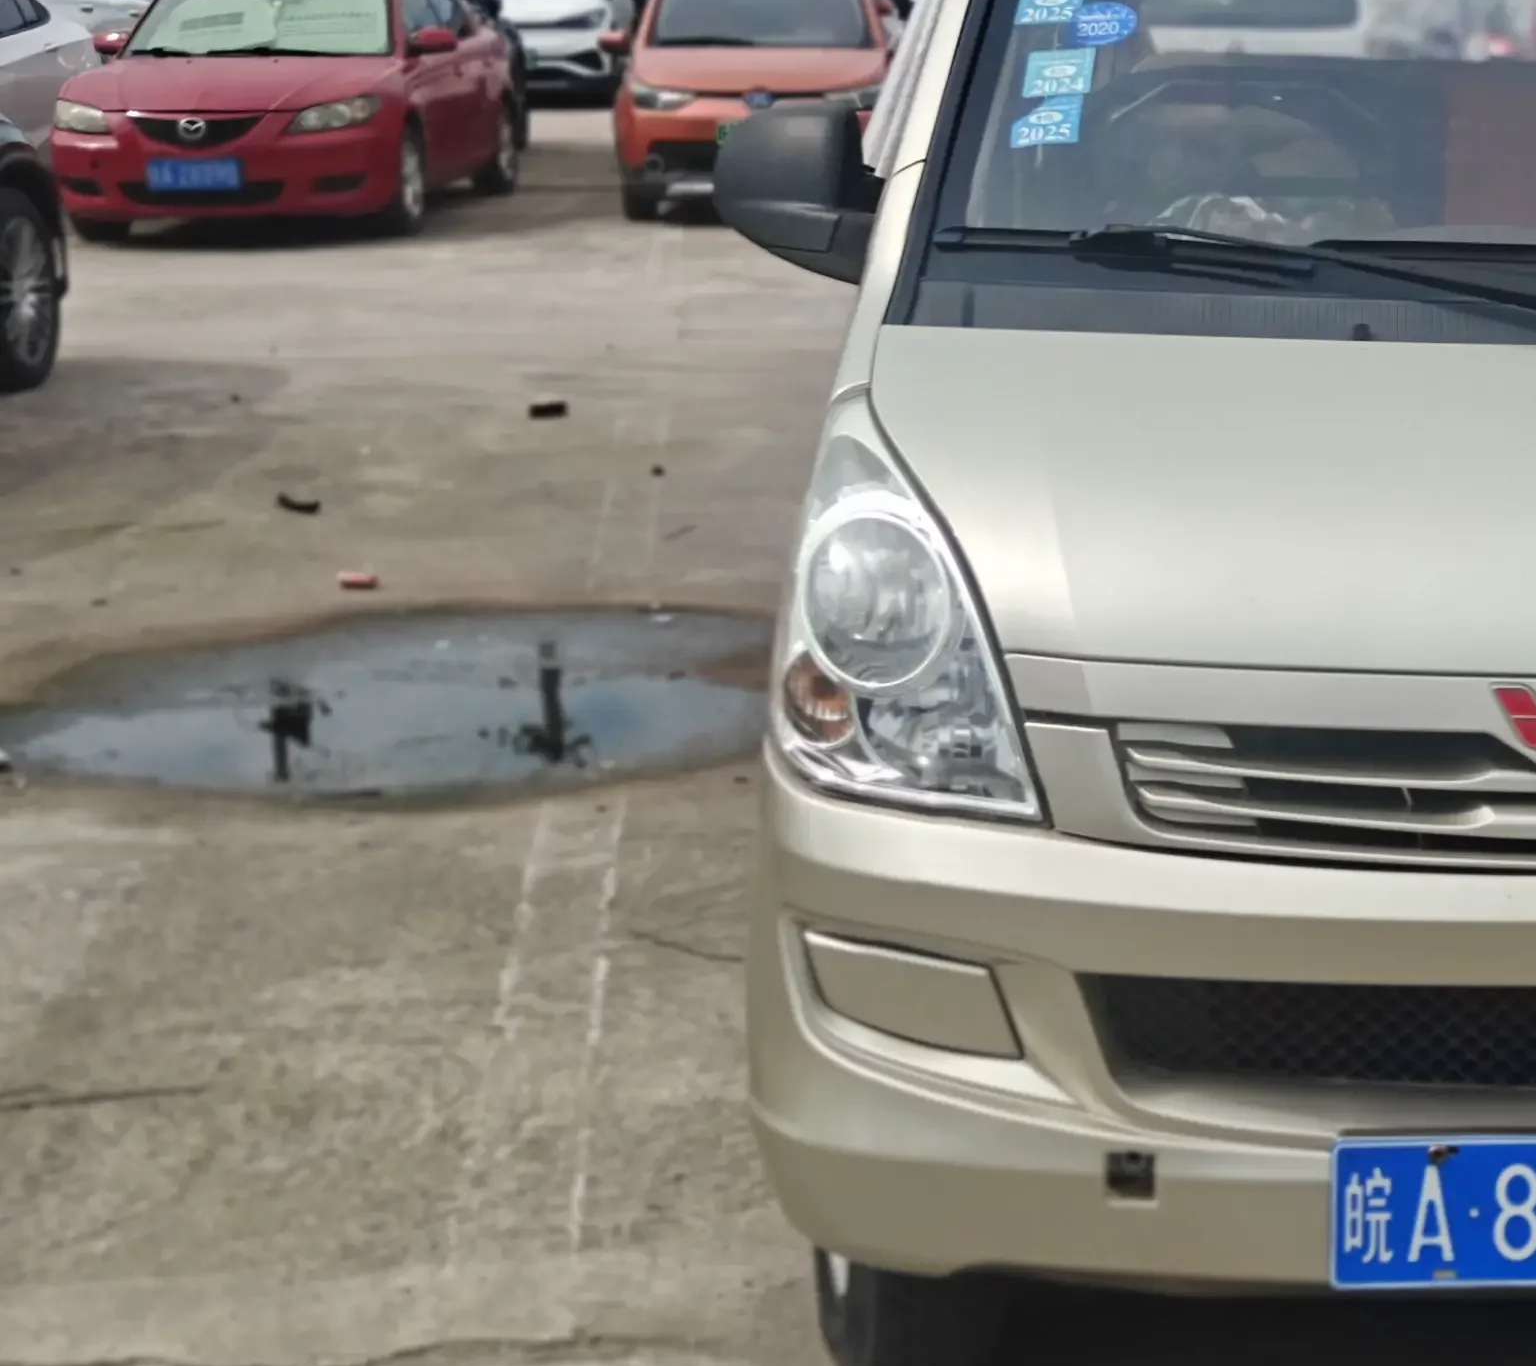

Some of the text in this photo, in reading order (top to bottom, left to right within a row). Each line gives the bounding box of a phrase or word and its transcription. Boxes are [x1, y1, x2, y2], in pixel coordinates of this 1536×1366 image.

[1020, 6, 1073, 23] 2025
[1077, 21, 1119, 37] 2020
[1031, 77, 1084, 94] 2024
[1017, 123, 1071, 144] 2025
